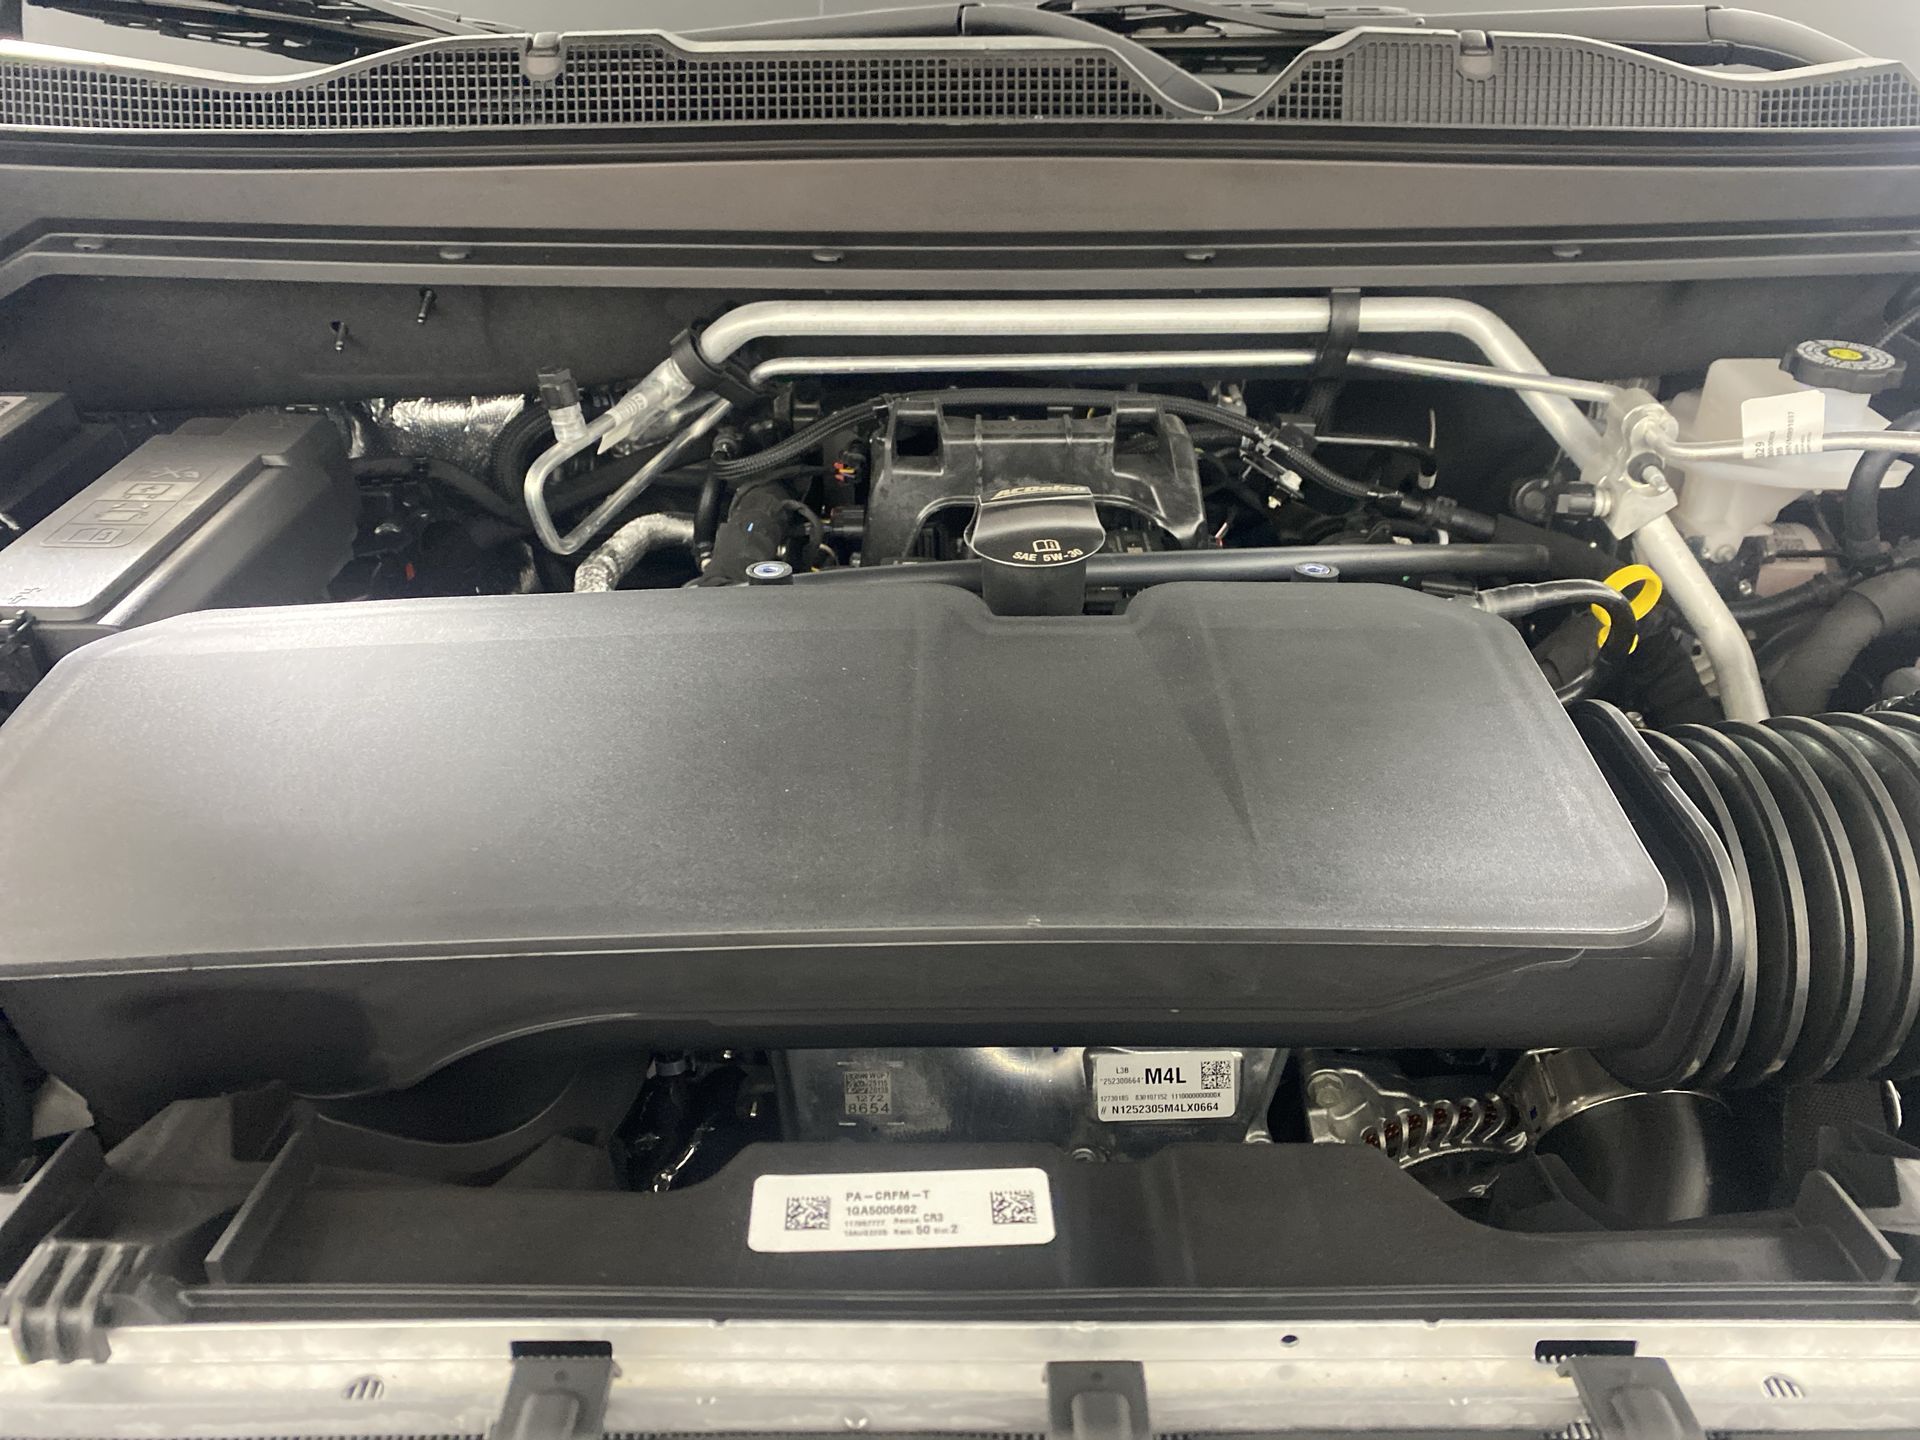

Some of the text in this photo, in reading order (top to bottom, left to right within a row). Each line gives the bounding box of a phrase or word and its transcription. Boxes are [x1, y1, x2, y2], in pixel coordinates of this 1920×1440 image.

[1012, 548, 1084, 562] SAE 5W-30
[1115, 1066, 1129, 1075] L3B
[1145, 1066, 1187, 1085] M4L
[856, 1095, 884, 1103] 1272
[847, 1103, 890, 1114] 8654
[1112, 1102, 1219, 1115] N1252305M4LX0664
[949, 1223, 959, 1235] 2
